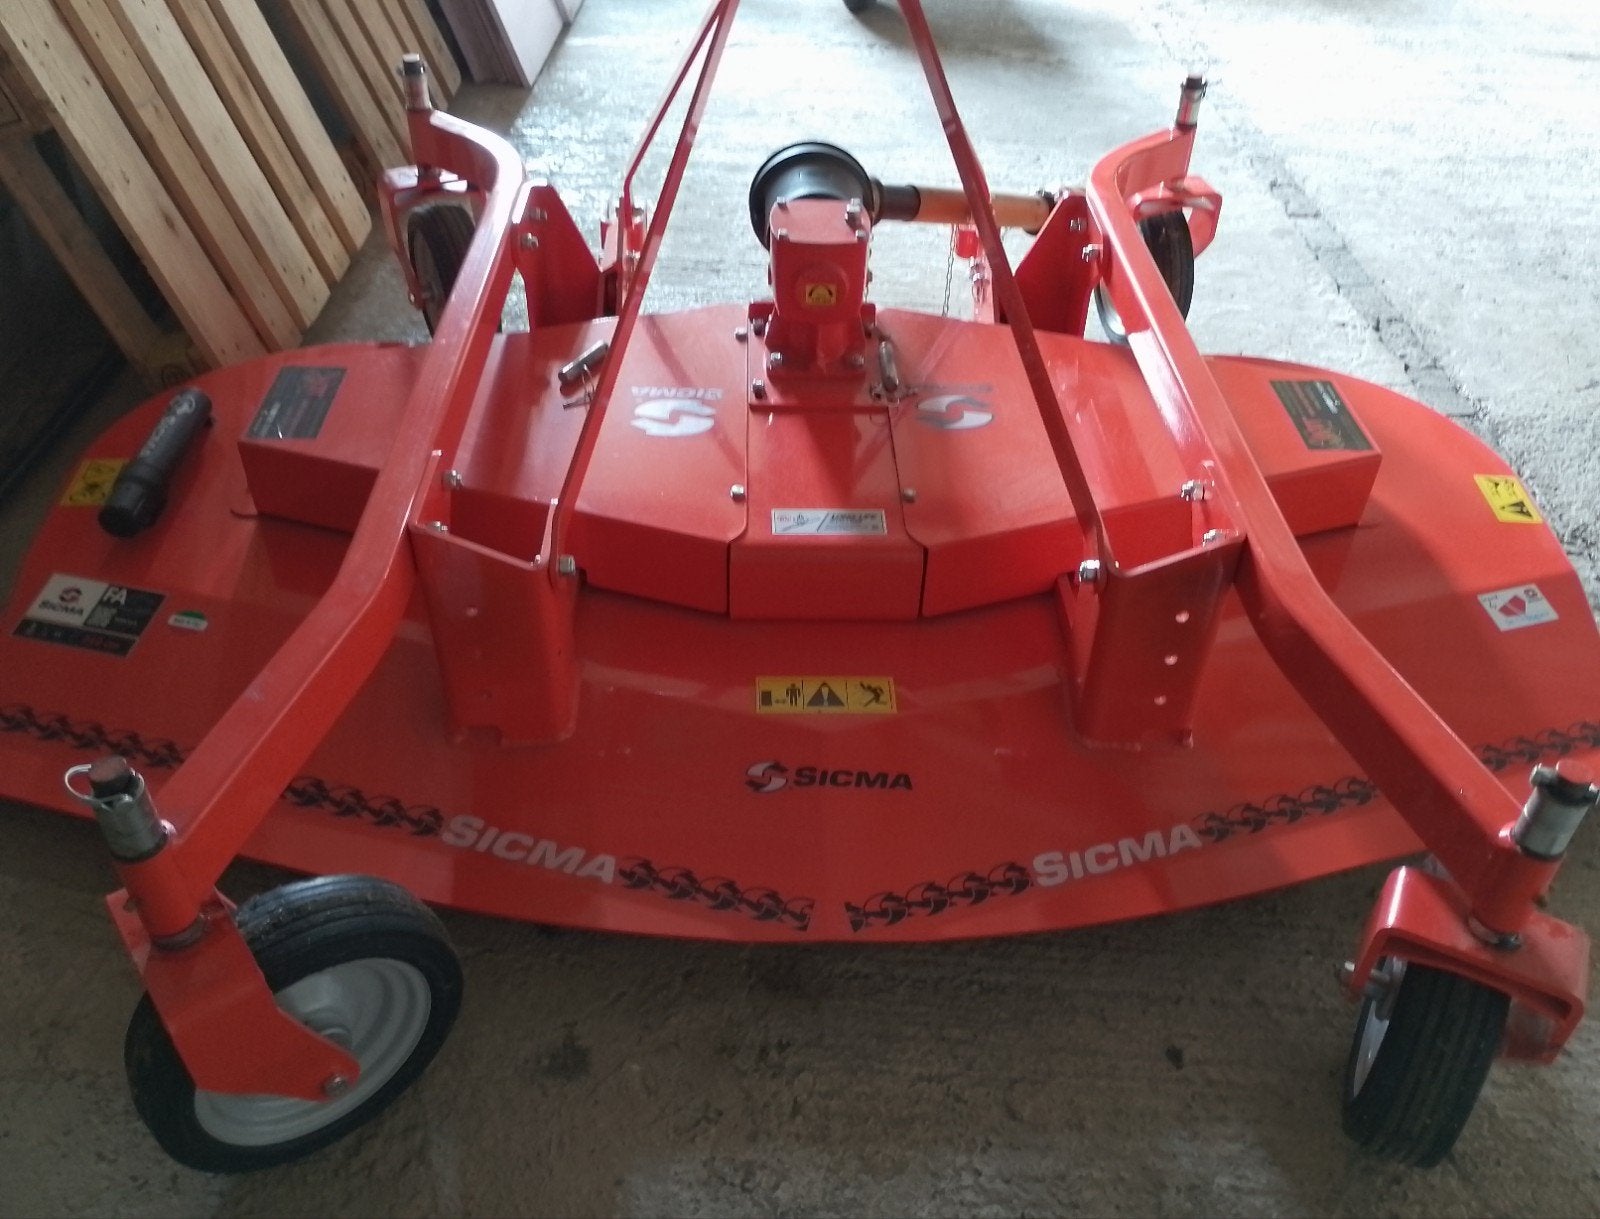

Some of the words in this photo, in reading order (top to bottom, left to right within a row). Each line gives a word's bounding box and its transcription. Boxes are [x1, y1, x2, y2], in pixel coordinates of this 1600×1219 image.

[631, 386, 722, 400] SICMA
[793, 767, 913, 790] SICMA
[442, 814, 616, 884] SICMA
[1033, 824, 1202, 887] SICMA
